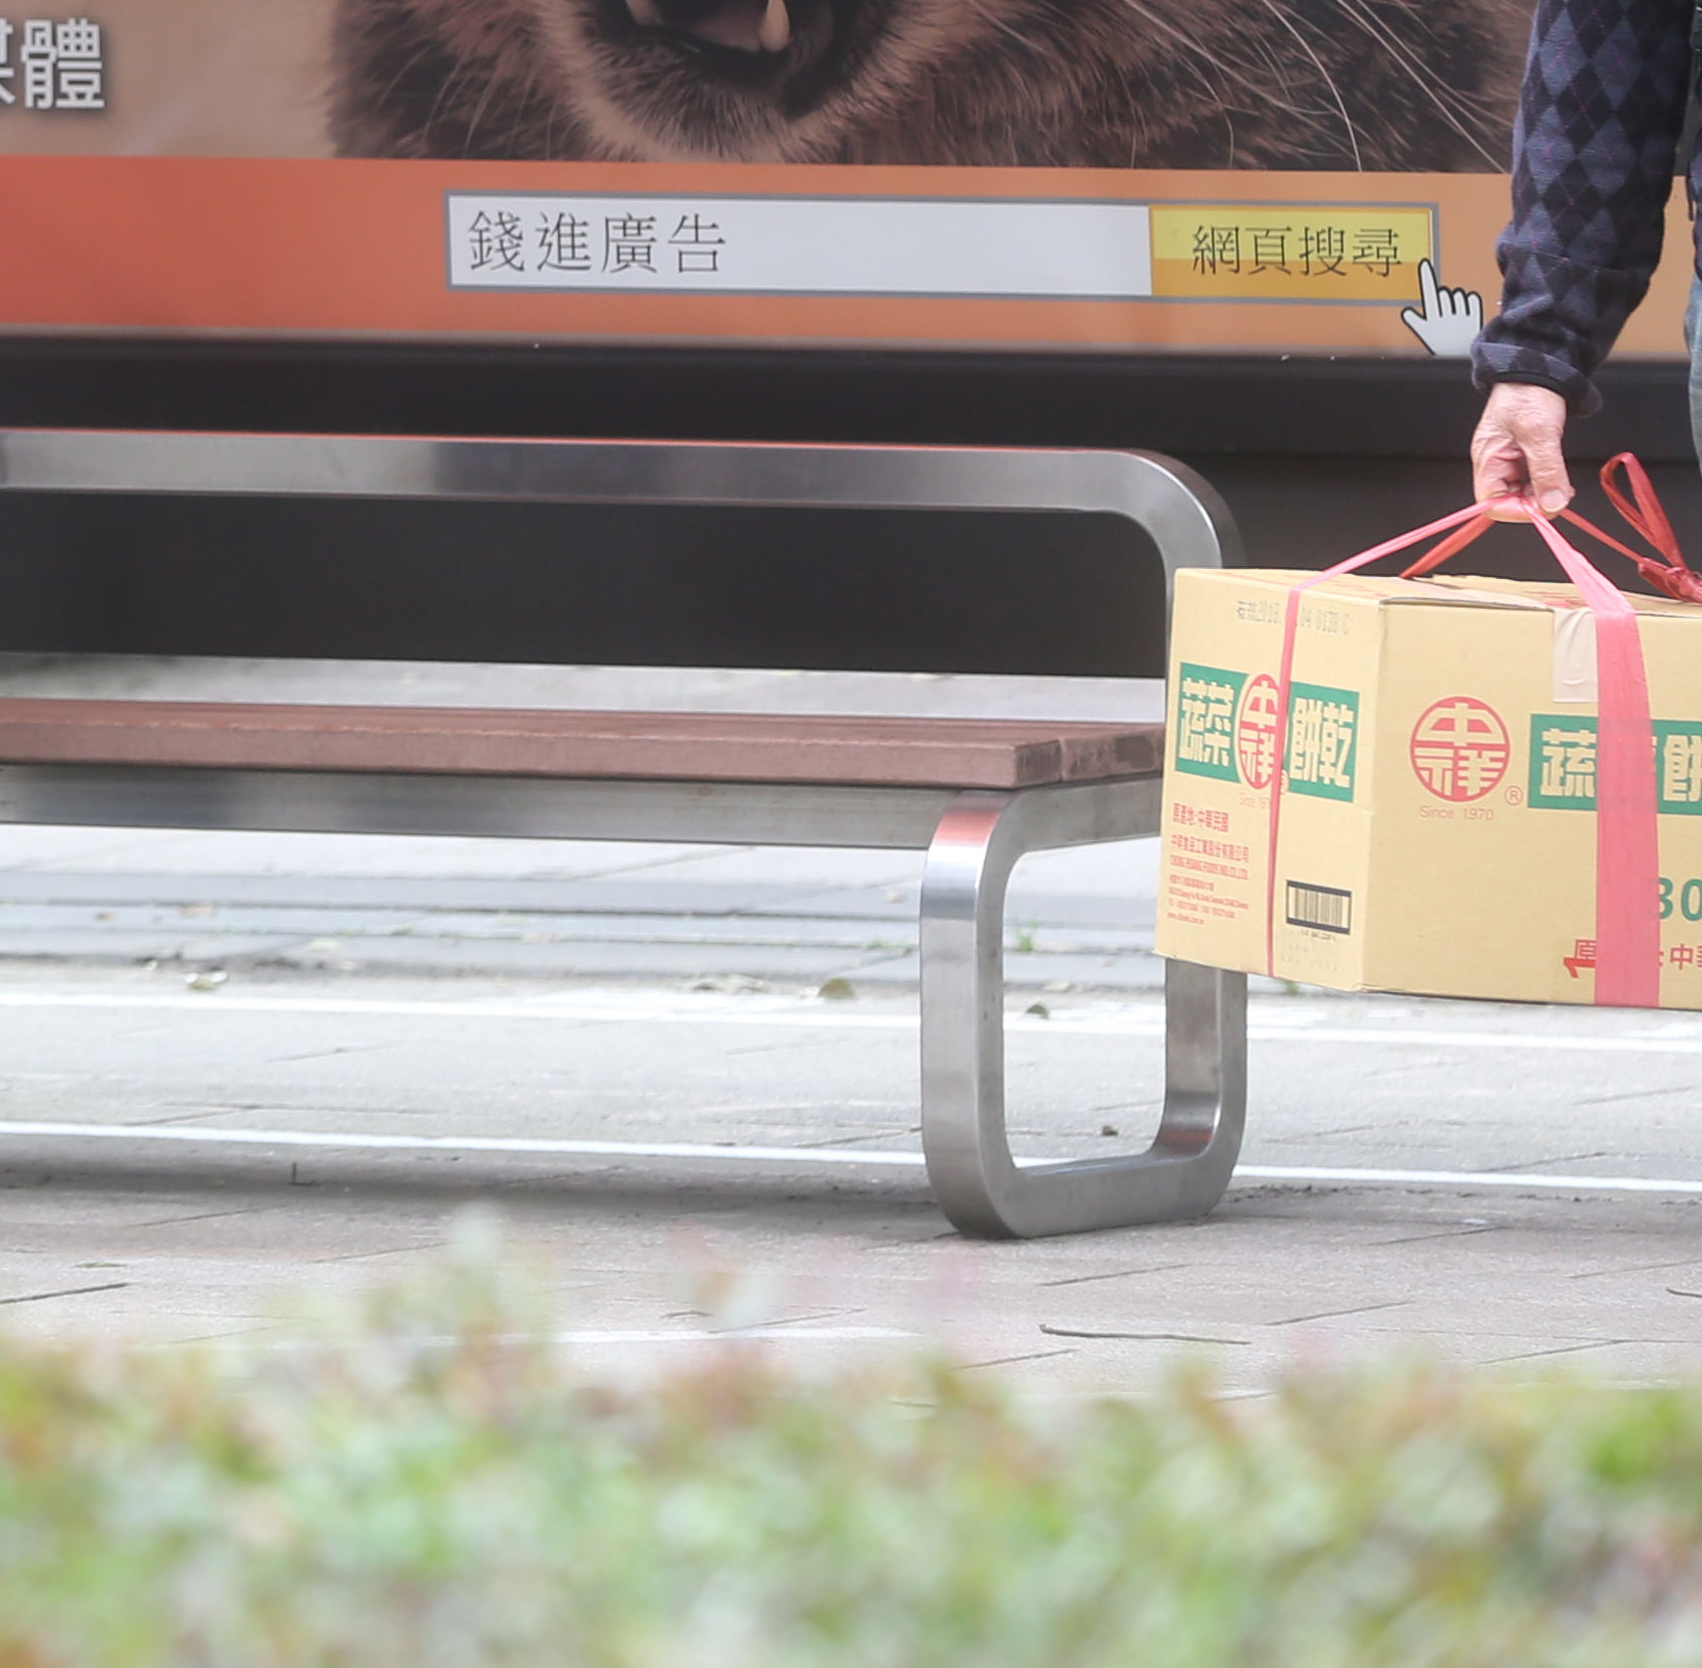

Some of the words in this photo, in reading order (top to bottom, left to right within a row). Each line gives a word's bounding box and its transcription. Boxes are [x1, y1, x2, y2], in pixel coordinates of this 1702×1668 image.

[468, 209, 727, 277] 錢進廣告
[1191, 222, 1401, 278] 網頁搜尋
[1179, 678, 1235, 767] 蔬菜
[1289, 697, 1355, 788] 餅乾
[1420, 804, 1455, 820] Since
[1463, 807, 1495, 821] 1970
